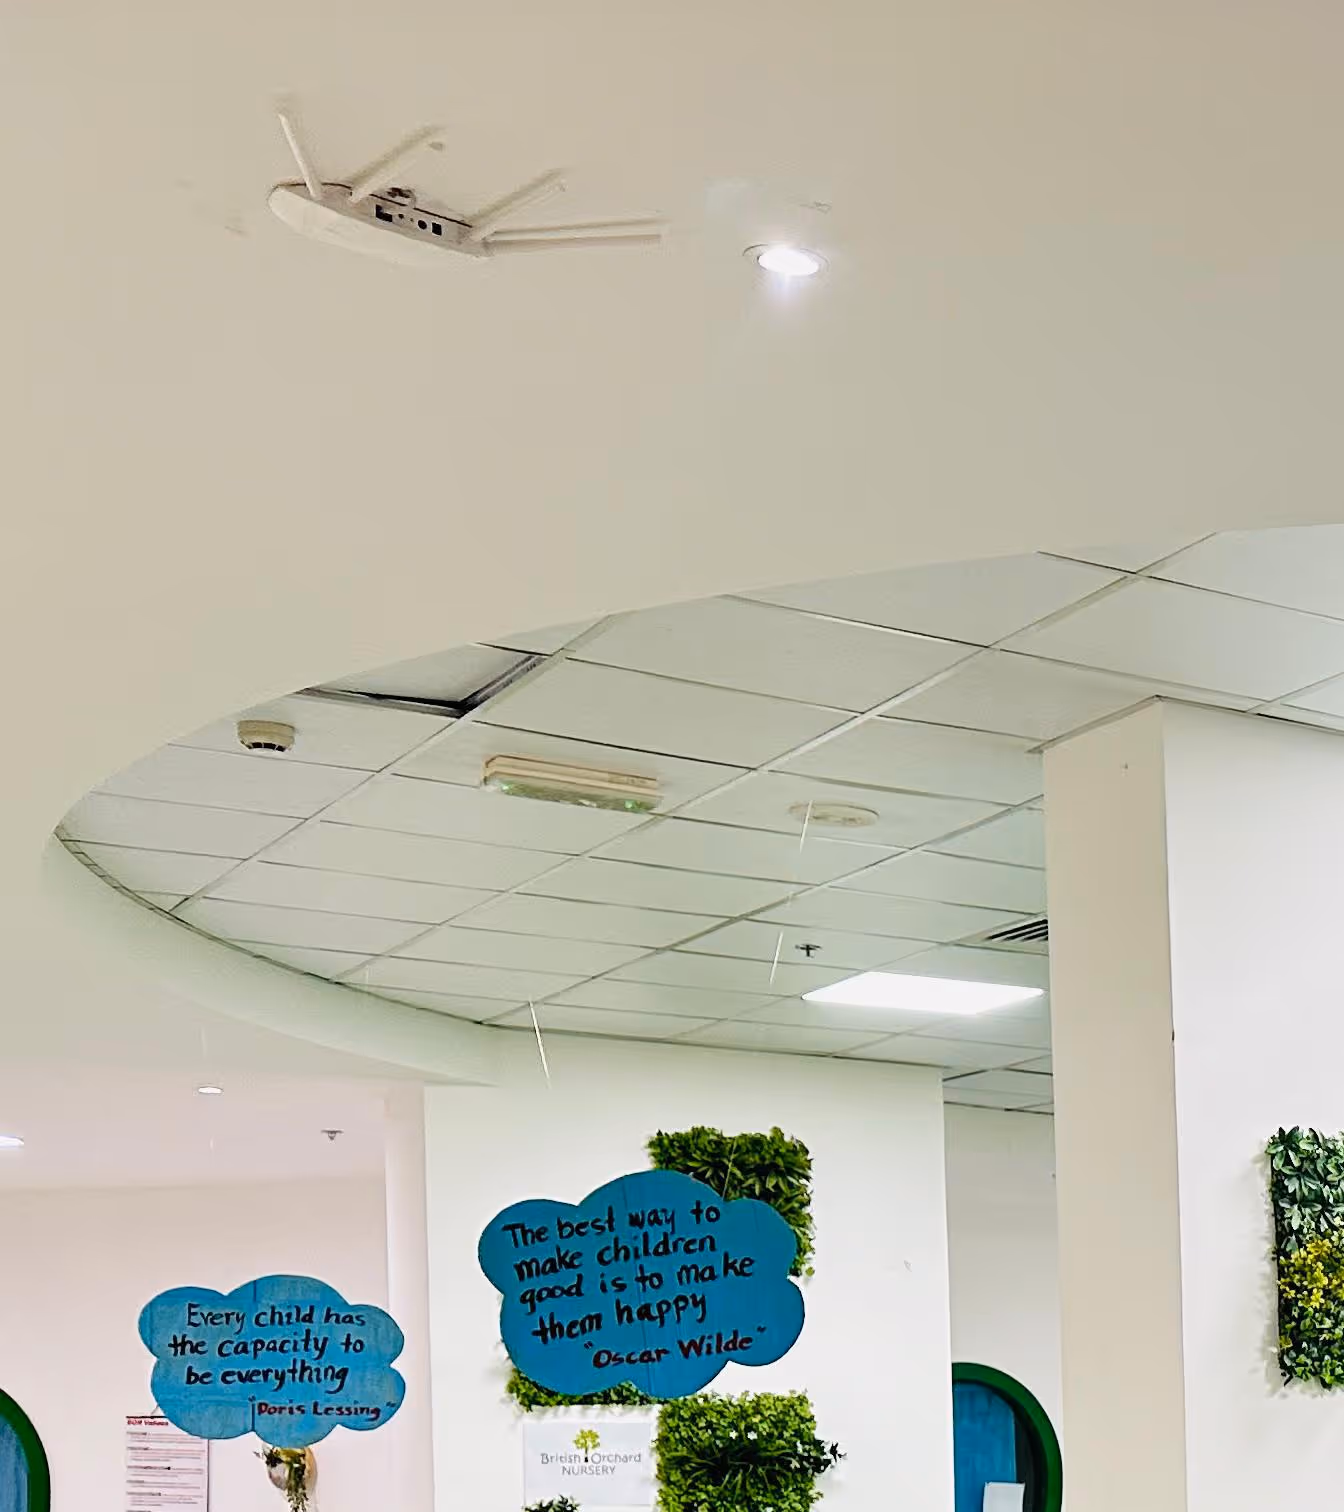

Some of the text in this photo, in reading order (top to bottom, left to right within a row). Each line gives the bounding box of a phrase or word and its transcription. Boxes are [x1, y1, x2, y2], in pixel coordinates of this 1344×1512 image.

[502, 1200, 720, 1249] The best way to
[513, 1231, 718, 1281] make children
[519, 1251, 755, 1315] good is to make
[186, 1303, 366, 1335] Every child has
[531, 1292, 707, 1344] them happy
[168, 1328, 364, 1360] the capacity to
[186, 1358, 349, 1394] be everything
[541, 1452, 642, 1464] British Orchard
[562, 1465, 617, 1476] NURSERY
